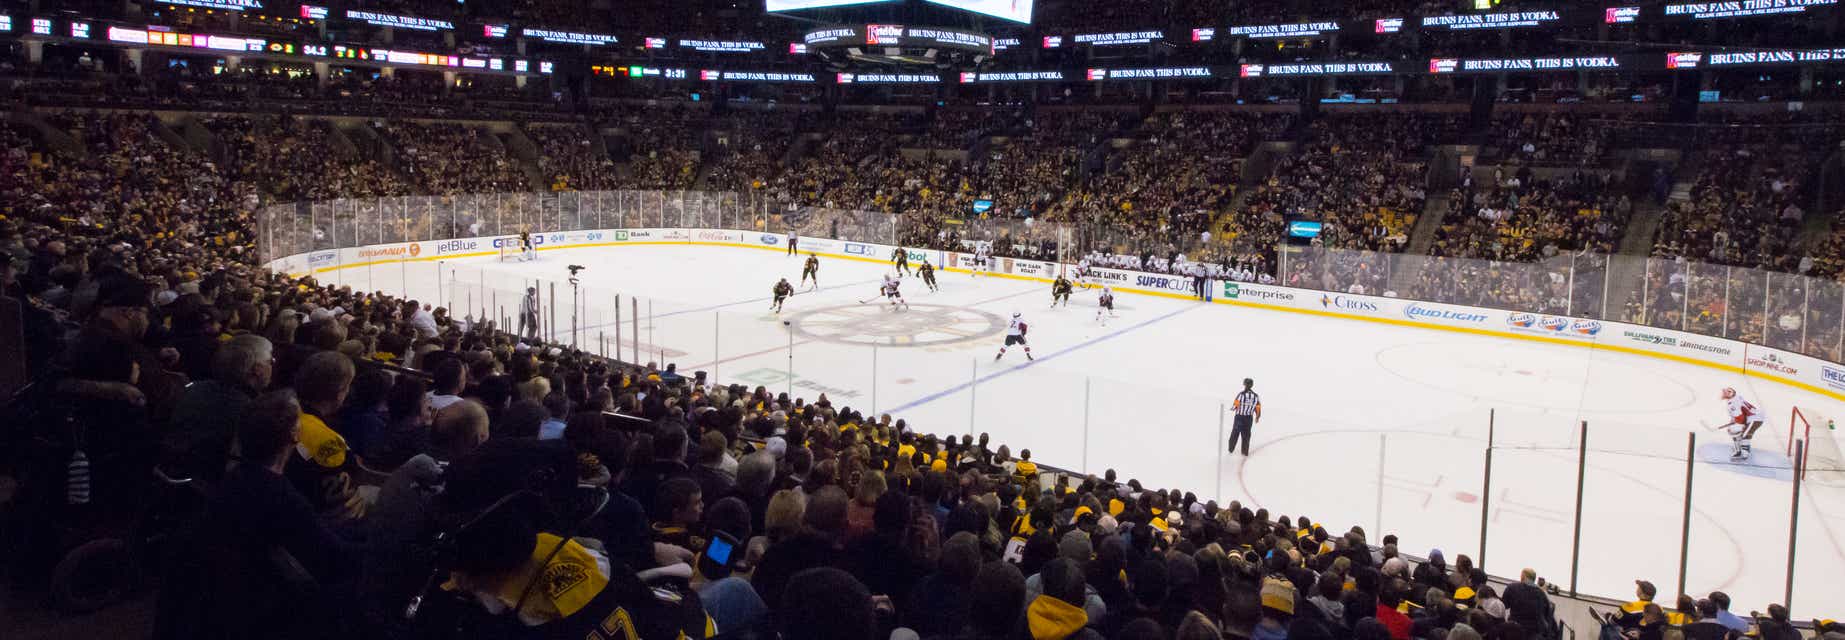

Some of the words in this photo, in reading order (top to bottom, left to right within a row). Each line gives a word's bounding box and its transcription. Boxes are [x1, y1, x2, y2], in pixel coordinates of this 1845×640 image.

[1666, 3, 1708, 15] BRUINS
[1709, 1, 1741, 13] FANS,
[1743, 0, 1770, 9] THIS
[399, 16, 417, 25] THIS
[1423, 16, 1457, 26] BRUINS
[1458, 15, 1484, 25] FANS,
[1485, 13, 1508, 23] THIS
[1510, 13, 1519, 22] IS
[1521, 11, 1560, 22] VODKA.
[1231, 26, 1257, 35] BRUINS
[1280, 24, 1298, 33] THIS
[1299, 23, 1308, 32] IS
[1309, 22, 1340, 31] VODKA.
[1075, 35, 1097, 43] BRUINS
[1115, 33, 1131, 41] THIS
[303, 45, 327, 56] 34.2
[1465, 60, 1502, 70] BRUINS
[1503, 59, 1533, 70] FANS,
[1534, 58, 1560, 68] THIS
[1562, 58, 1574, 68] IS
[1575, 57, 1619, 68] VODKA.
[1710, 53, 1756, 65] BRUINS
[1758, 51, 1794, 63] FANS,
[665, 68, 685, 78] 3:31
[980, 72, 1001, 80] BRUINS
[1017, 72, 1032, 80] THIS
[1039, 71, 1063, 80] VODKA.
[1110, 70, 1135, 78] BRUINS
[1156, 69, 1173, 77] THIS
[1174, 69, 1182, 77] IS
[1182, 68, 1211, 77] VODKA.
[1268, 66, 1299, 75] BRUINS
[1300, 65, 1323, 75] FANS,
[1325, 64, 1347, 73] THIS
[1347, 64, 1356, 73] IS
[1357, 63, 1393, 72] VODKA.
[724, 72, 748, 80] BRUINS
[767, 73, 782, 81] THIS
[437, 239, 478, 254] jetBlue
[493, 235, 544, 249] GEIO
[1224, 281, 1295, 301] enterprise
[1334, 295, 1378, 312] CROSS
[1409, 306, 1442, 318] BUD
[1444, 310, 1489, 323] LIGHT
[1680, 340, 1731, 357] BRIDGESTONE
[1824, 369, 1838, 381] THE
